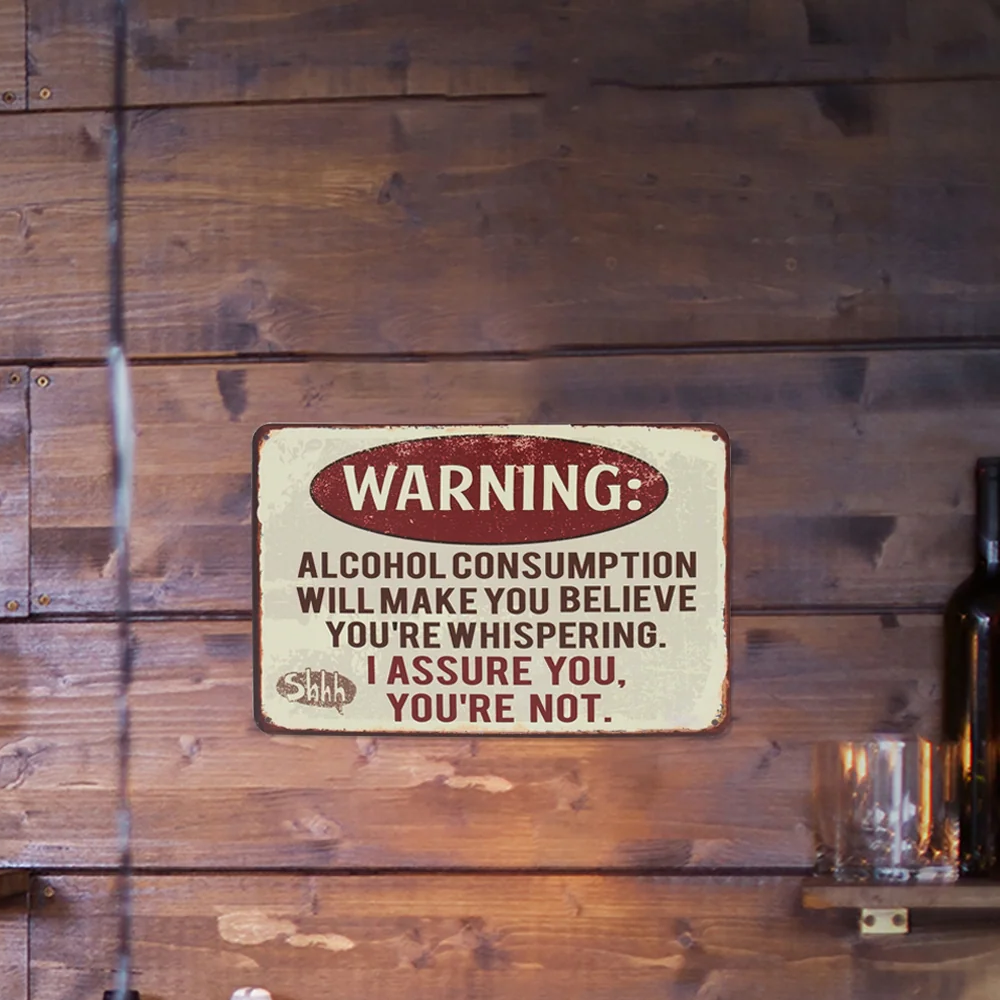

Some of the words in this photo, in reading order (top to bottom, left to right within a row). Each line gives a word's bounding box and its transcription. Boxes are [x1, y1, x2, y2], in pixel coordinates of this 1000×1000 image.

[343, 464, 642, 512] WARNING:
[298, 551, 446, 579] ALCOHOL
[452, 551, 697, 579] CONSUMPTION
[297, 587, 375, 614] WILL
[381, 587, 477, 614] MAKE
[484, 586, 548, 614] YOU
[560, 585, 696, 612] BELIEVE
[326, 622, 440, 648] YOU'RE
[448, 622, 666, 649] WHISPERING.
[285, 668, 346, 702] Shhh
[367, 655, 375, 685] I
[387, 656, 532, 685] ASSURE
[544, 656, 625, 688] YOU,
[387, 693, 514, 722] YOU'RE
[530, 693, 611, 722] NOT.
